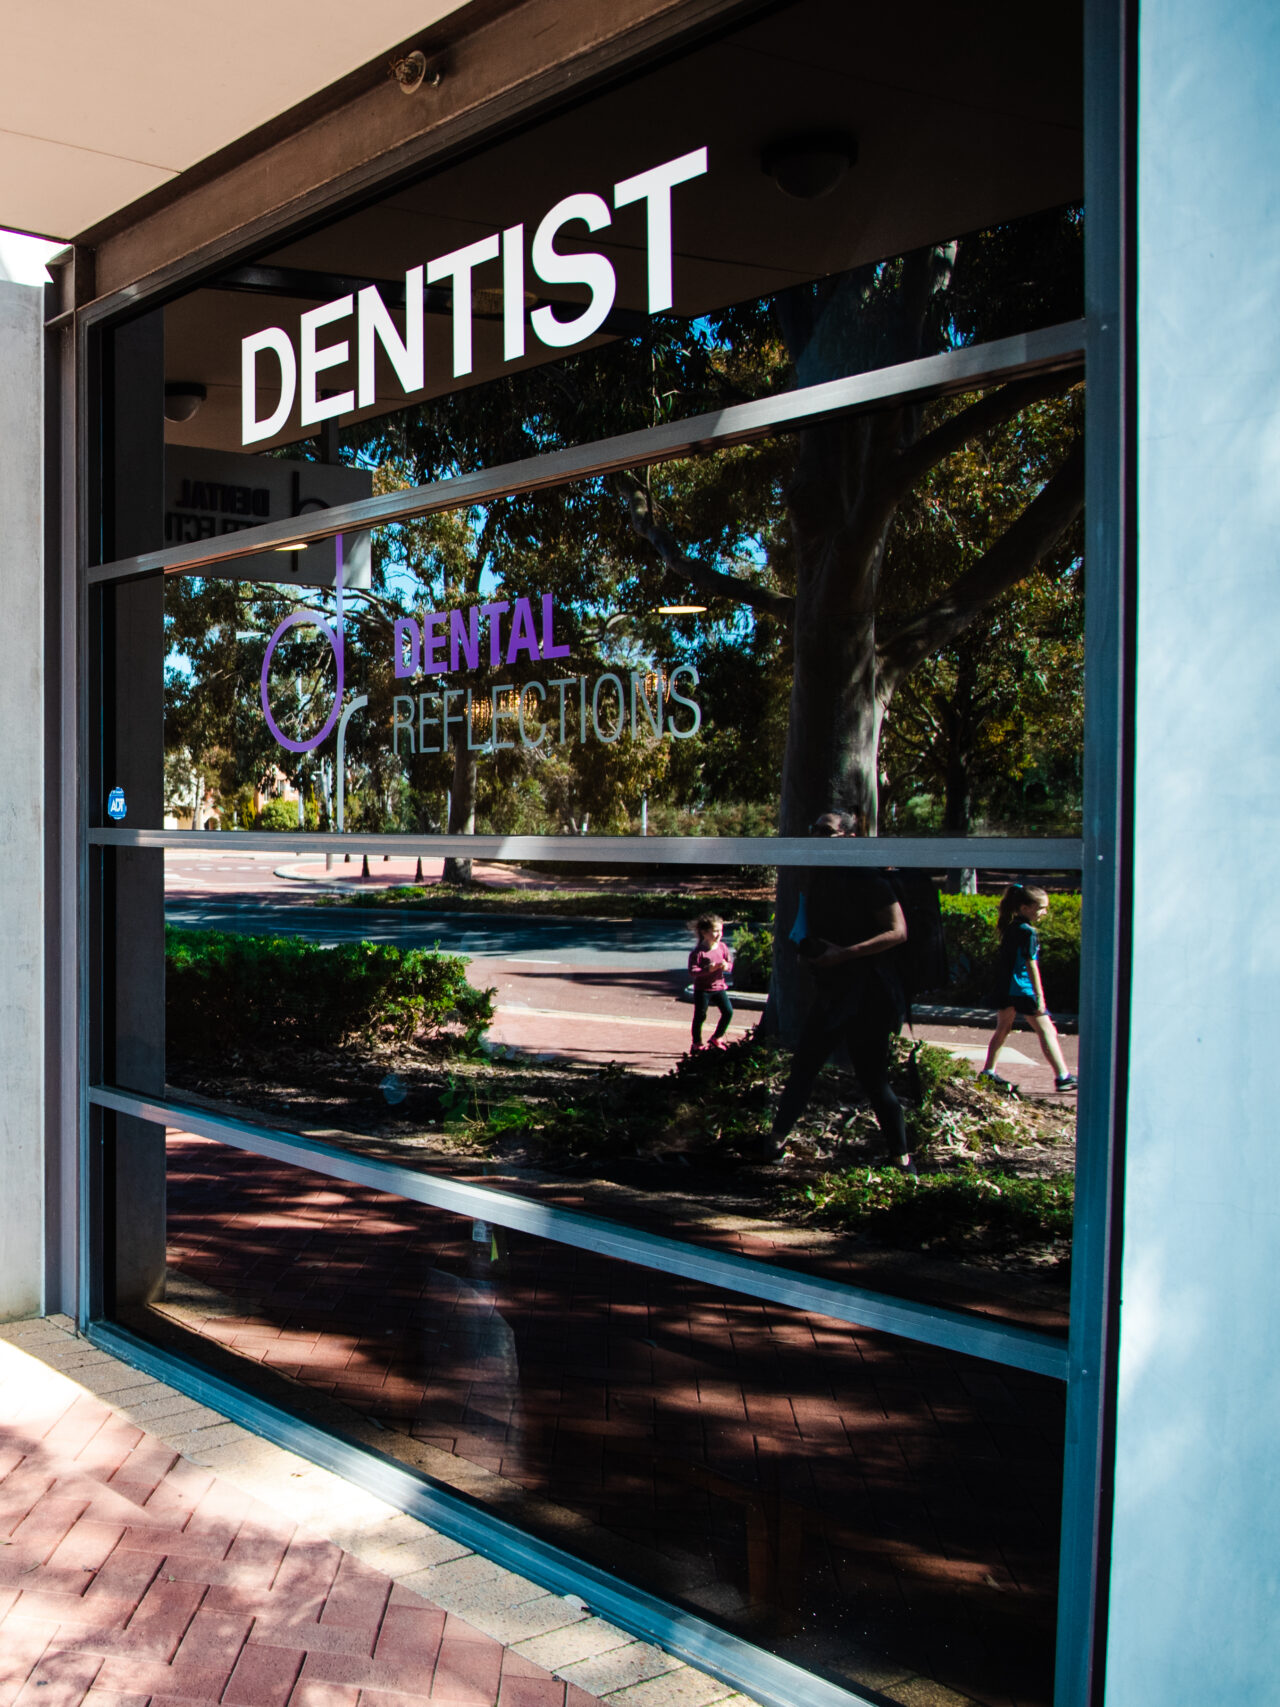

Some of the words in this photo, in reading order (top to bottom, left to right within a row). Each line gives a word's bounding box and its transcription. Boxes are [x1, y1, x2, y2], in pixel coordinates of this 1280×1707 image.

[241, 146, 708, 446] DENTIST
[394, 593, 571, 679] DENTAL
[393, 665, 702, 754] REFLECTIONS
[110, 798, 125, 812] ADT
